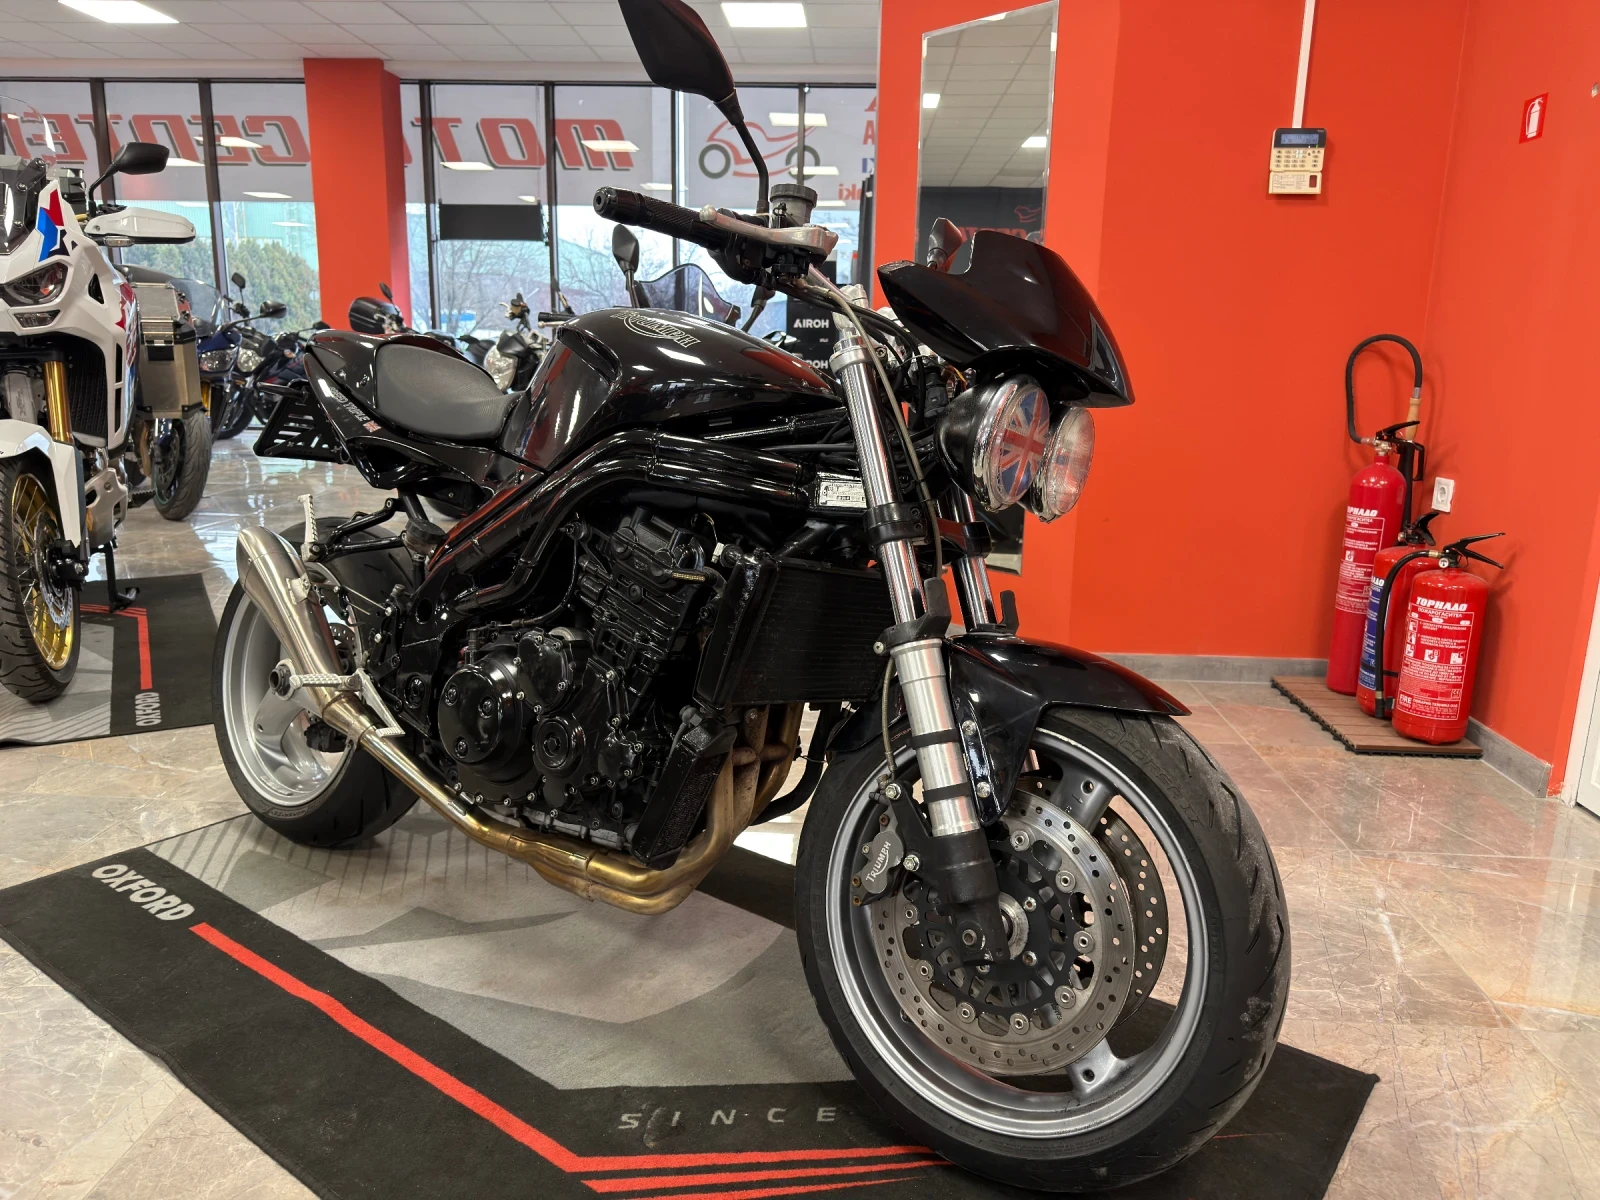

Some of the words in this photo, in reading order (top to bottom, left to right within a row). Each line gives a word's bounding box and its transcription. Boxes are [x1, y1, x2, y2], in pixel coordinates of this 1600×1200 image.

[610, 310, 701, 348] TRIUMPH
[793, 318, 830, 329] AIROH
[342, 401, 371, 422] TRIPLE
[1416, 596, 1468, 612] ТОРНАДО
[135, 691, 162, 727] OXFORD
[1399, 694, 1412, 704] FIRE
[865, 840, 892, 883] TRIUMPH
[92, 863, 196, 921] OXFORD
[618, 1106, 838, 1130] SINCE
